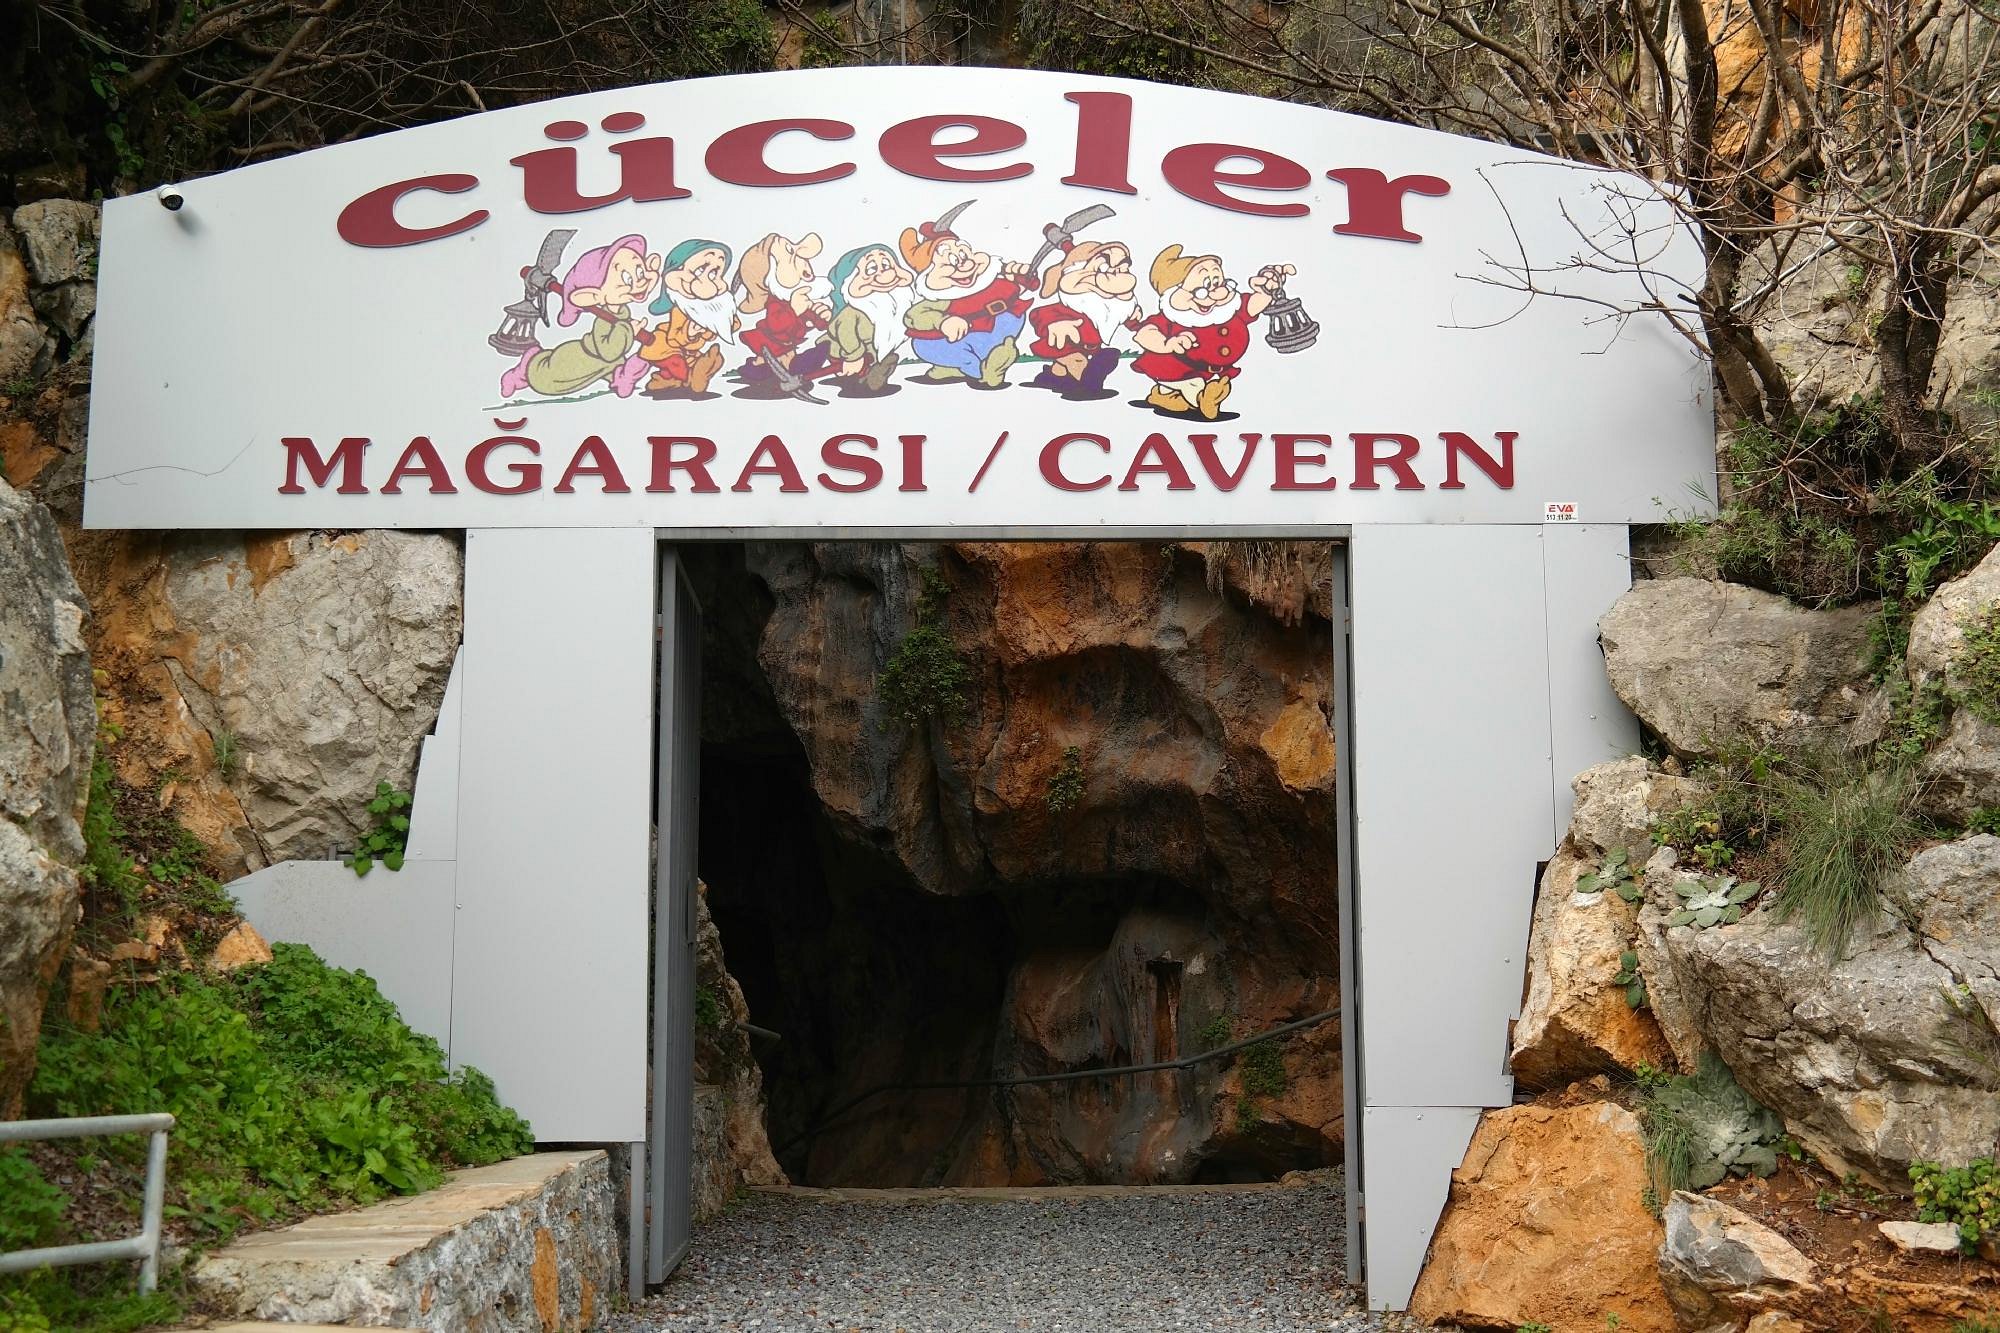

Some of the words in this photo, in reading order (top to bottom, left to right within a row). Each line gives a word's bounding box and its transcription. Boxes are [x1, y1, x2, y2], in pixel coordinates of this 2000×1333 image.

[337, 92, 1451, 247] cüceler
[279, 417, 927, 493] MAĞARASI
[969, 431, 1009, 493] /
[1039, 431, 1519, 491] CAVERN
[1548, 504, 1574, 513] EVA
